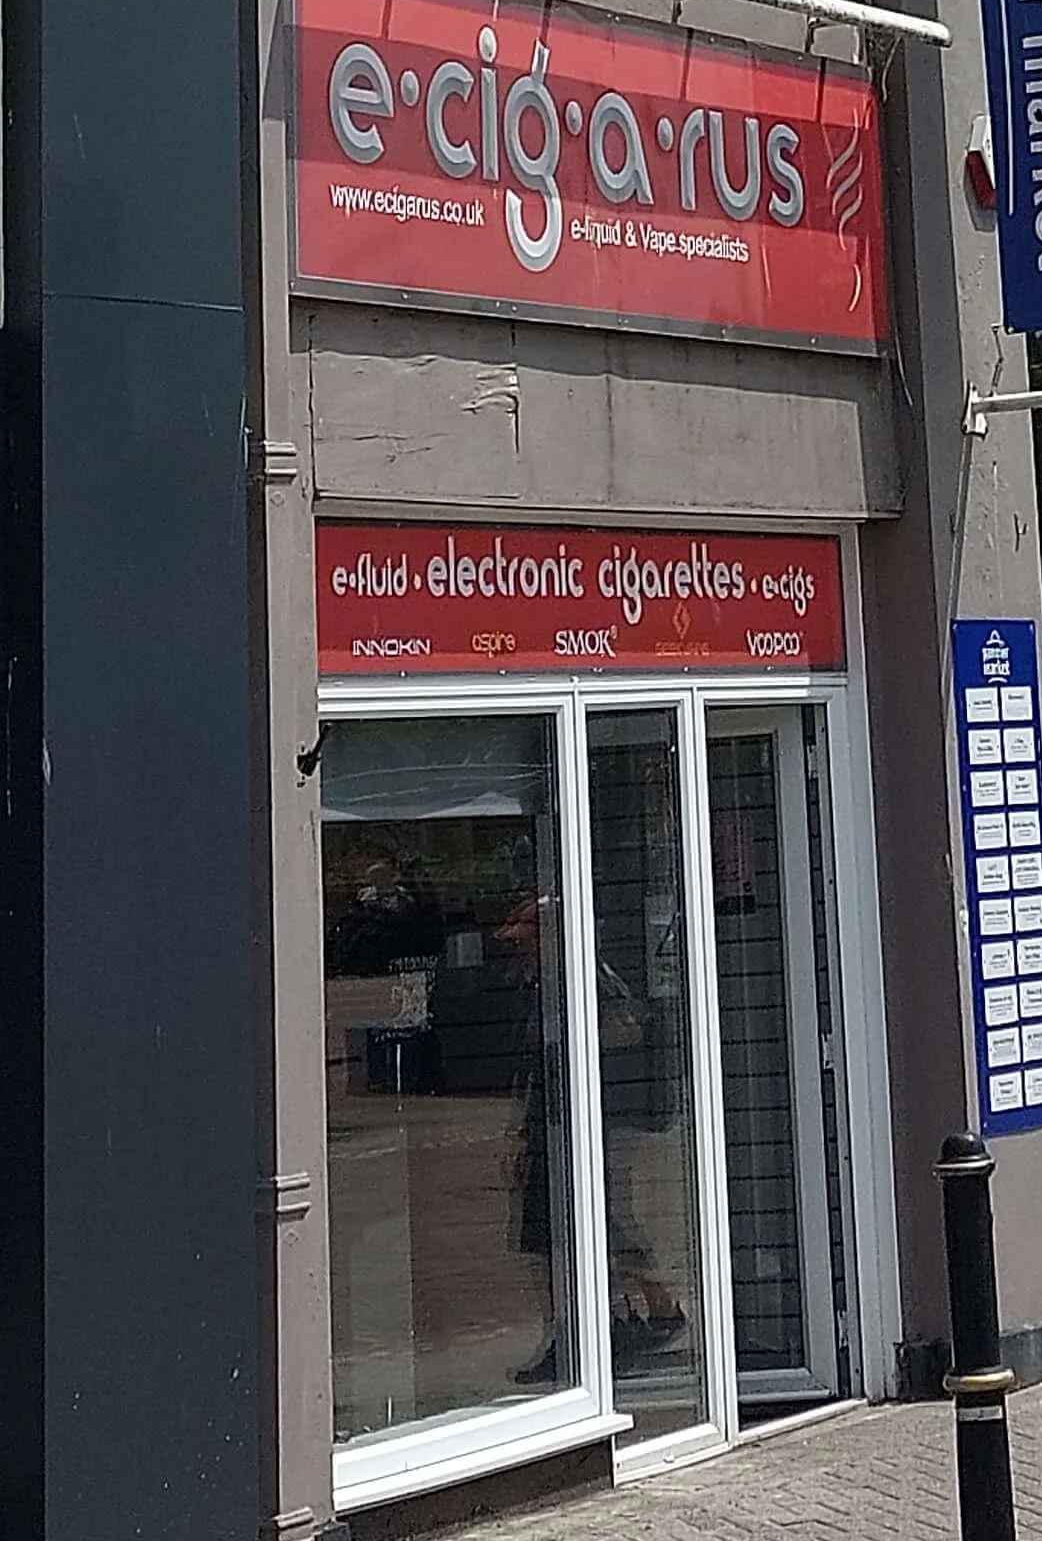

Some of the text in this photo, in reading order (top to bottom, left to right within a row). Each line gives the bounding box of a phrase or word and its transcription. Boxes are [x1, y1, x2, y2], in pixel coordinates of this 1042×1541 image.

[330, 183, 484, 226] www.ecigarus.co.uk
[571, 216, 750, 263] e-liquid & Vape specialists
[427, 535, 585, 598] electronic
[598, 541, 746, 625] cigarettes
[352, 638, 431, 656] INNOKIN
[472, 630, 516, 658] aspire
